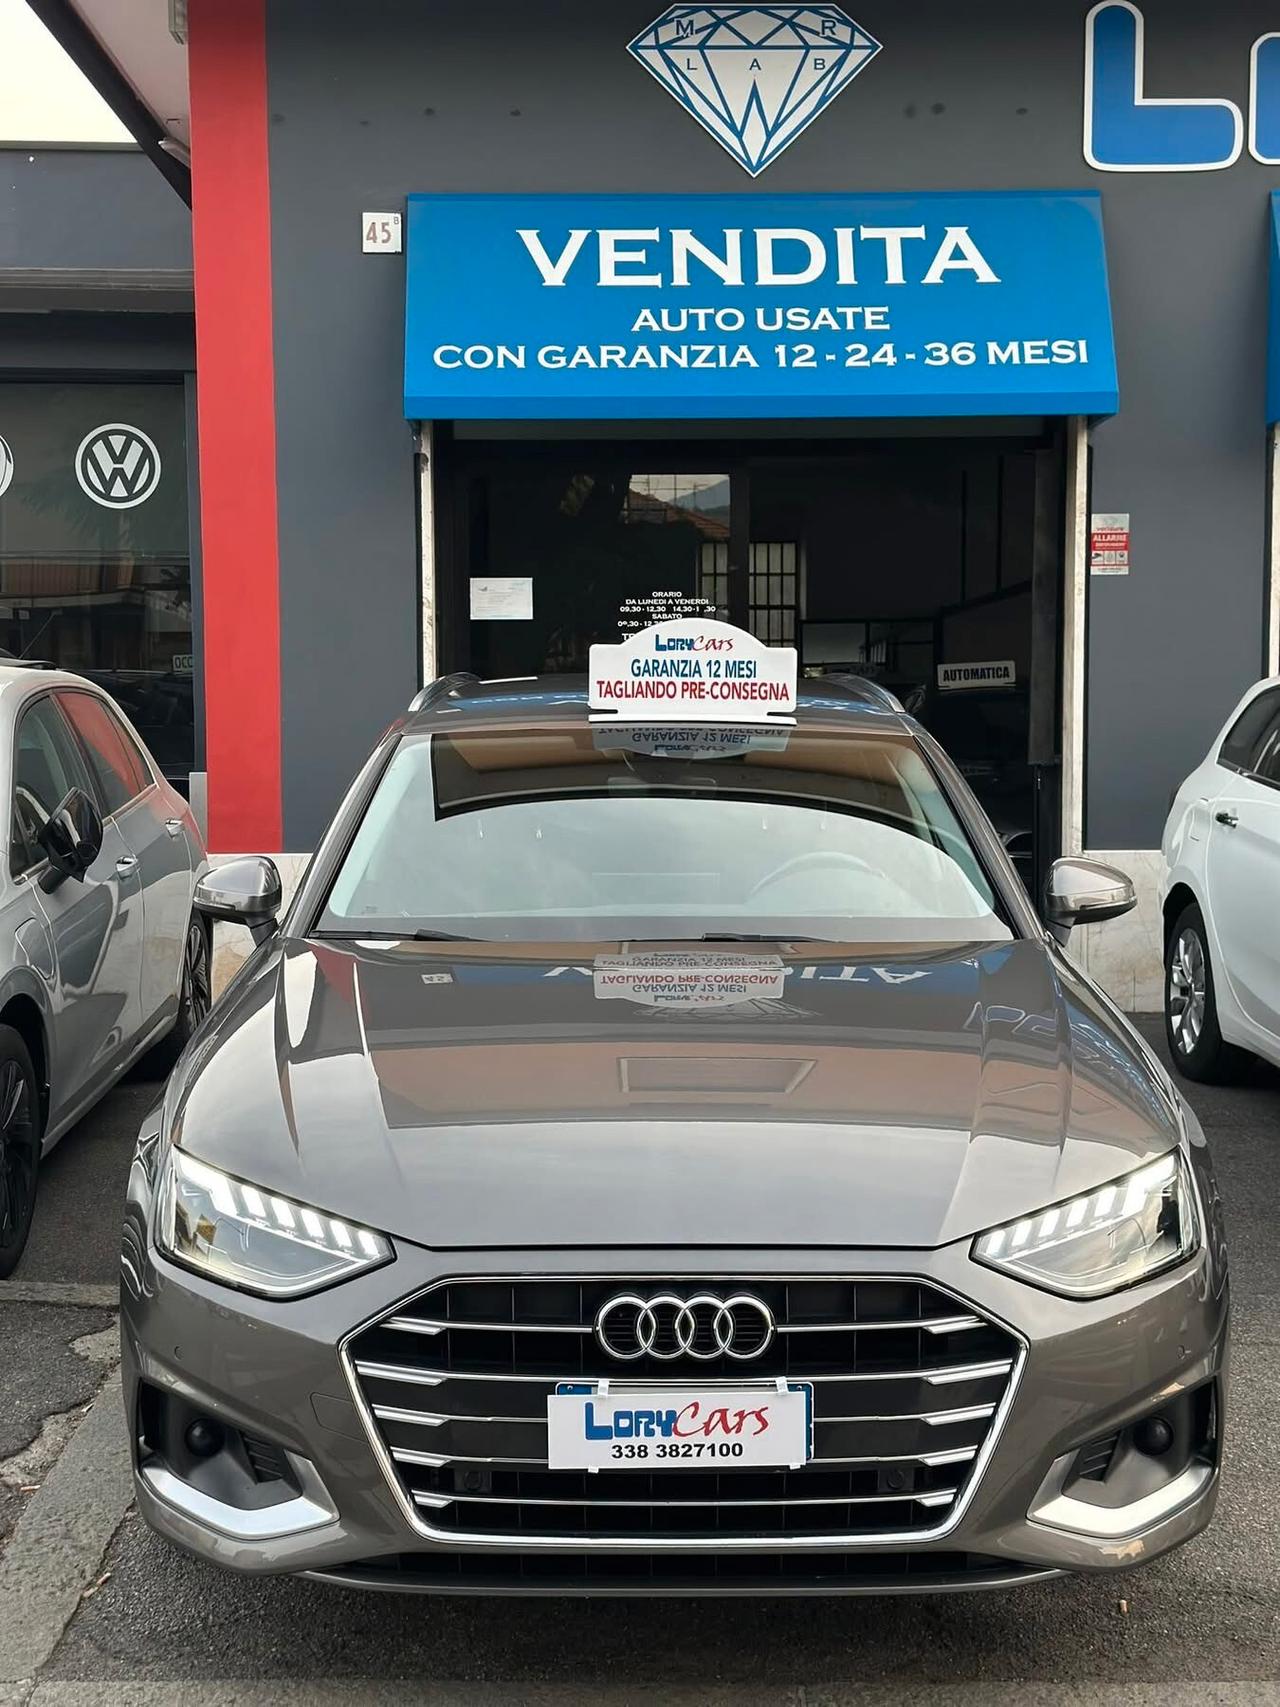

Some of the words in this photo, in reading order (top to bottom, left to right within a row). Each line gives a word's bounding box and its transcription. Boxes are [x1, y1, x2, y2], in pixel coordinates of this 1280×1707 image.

[676, 20, 694, 36] M
[821, 20, 837, 36] R
[1083, 0, 1280, 172] L
[366, 222, 392, 243] 45
[516, 225, 1001, 288] VENDITA
[631, 308, 745, 332] AUTO
[756, 305, 890, 331] USATE
[433, 345, 525, 369] CON
[537, 344, 758, 369] GARANZIA
[774, 344, 817, 368] 12
[845, 343, 897, 367] 24
[924, 342, 976, 366] 36
[987, 340, 1089, 365] MESI
[631, 659, 702, 678] GARANZIA
[706, 660, 721, 678] 12
[725, 660, 757, 678] MESI
[943, 666, 1010, 682] AUTOMATICA
[596, 680, 677, 698] TAGLIANDO
[681, 682, 789, 701] PRE-CONSEGNA
[611, 1444, 649, 1459] 338
[656, 1442, 743, 1458] 3827100
